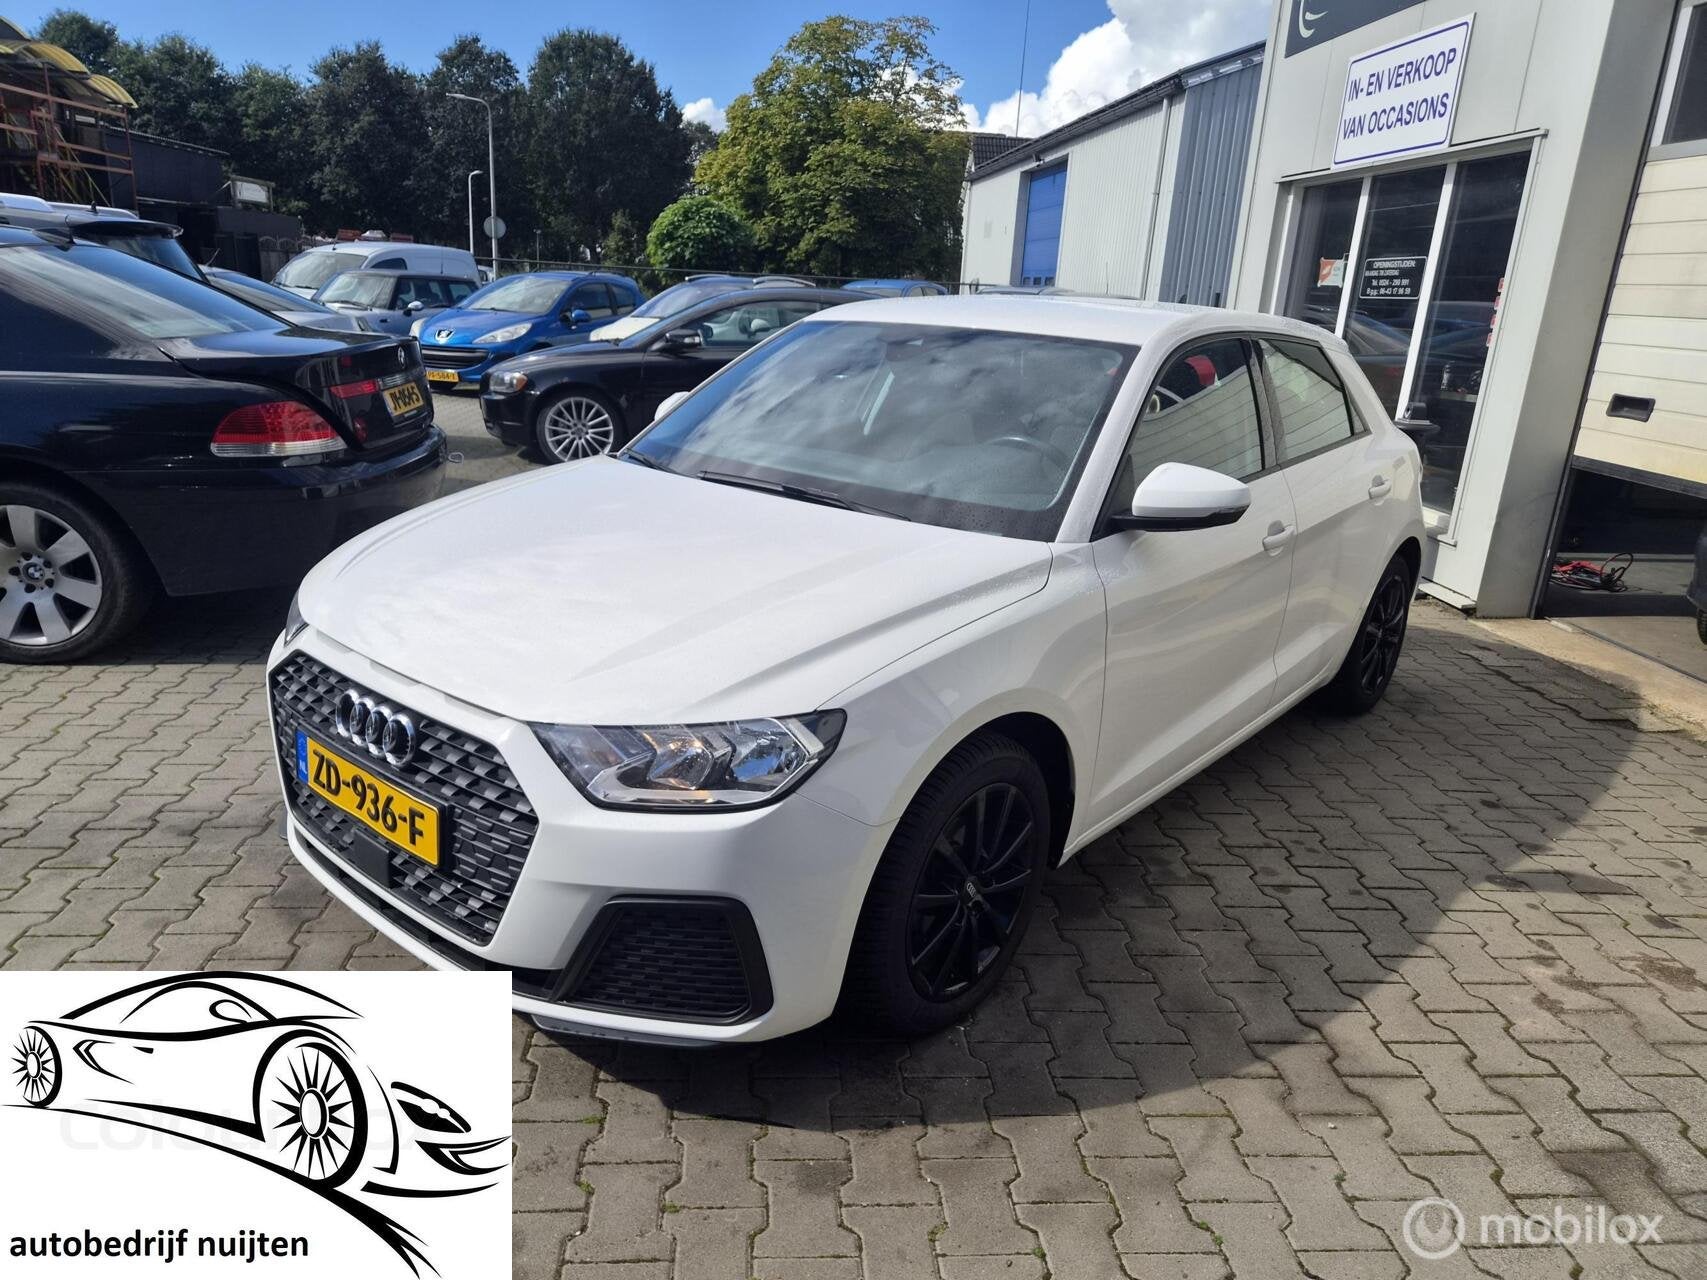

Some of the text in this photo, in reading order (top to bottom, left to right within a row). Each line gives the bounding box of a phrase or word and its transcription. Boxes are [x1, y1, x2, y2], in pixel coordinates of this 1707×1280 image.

[1347, 47, 1457, 102] IN- EN VERKOOP
[1343, 92, 1449, 140] VAN OCCASIONS
[313, 749, 425, 847] ZD-936-F
